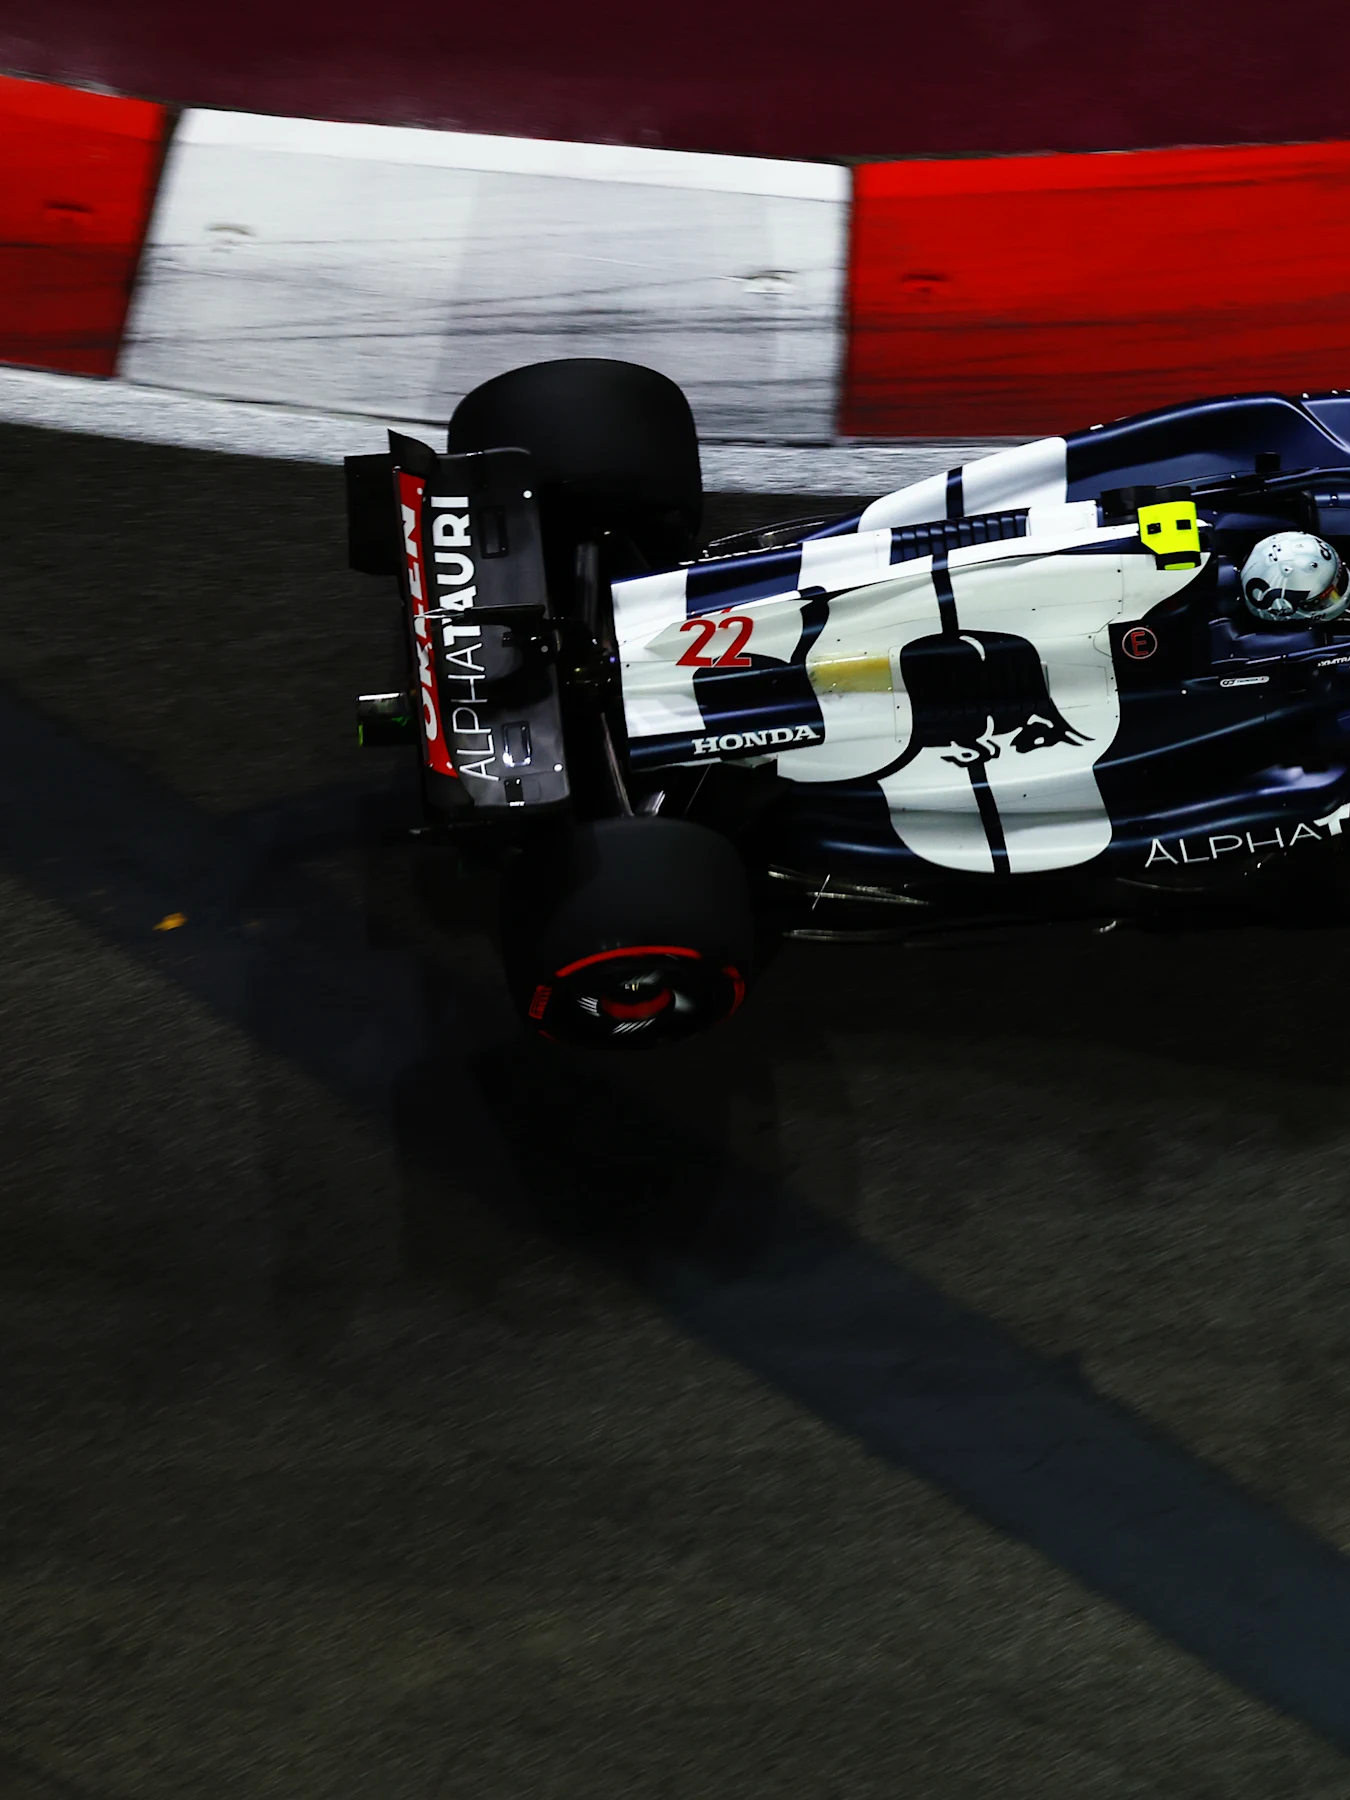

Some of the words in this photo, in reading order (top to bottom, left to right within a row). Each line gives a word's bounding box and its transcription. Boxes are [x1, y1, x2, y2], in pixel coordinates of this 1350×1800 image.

[430, 496, 500, 781] ALPHATAURI
[675, 609, 754, 668] 22
[1130, 630, 1148, 659] E
[691, 724, 820, 756] HONDA
